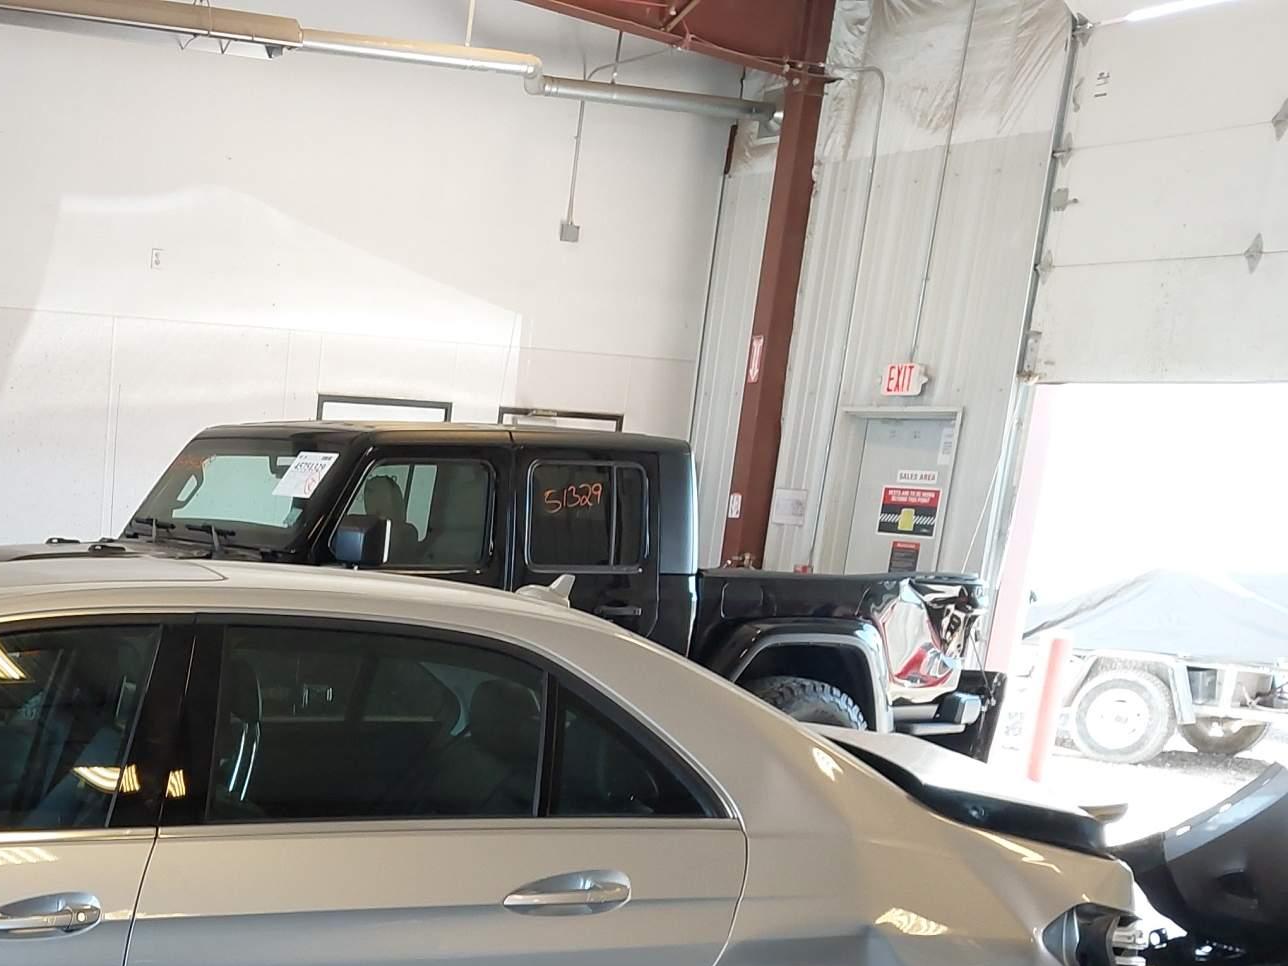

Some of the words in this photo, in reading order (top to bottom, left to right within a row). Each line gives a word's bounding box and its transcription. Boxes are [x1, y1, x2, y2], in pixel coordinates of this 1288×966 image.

[887, 365, 915, 392] EXIT
[919, 473, 936, 481] AREA
[544, 482, 603, 514] 51329
